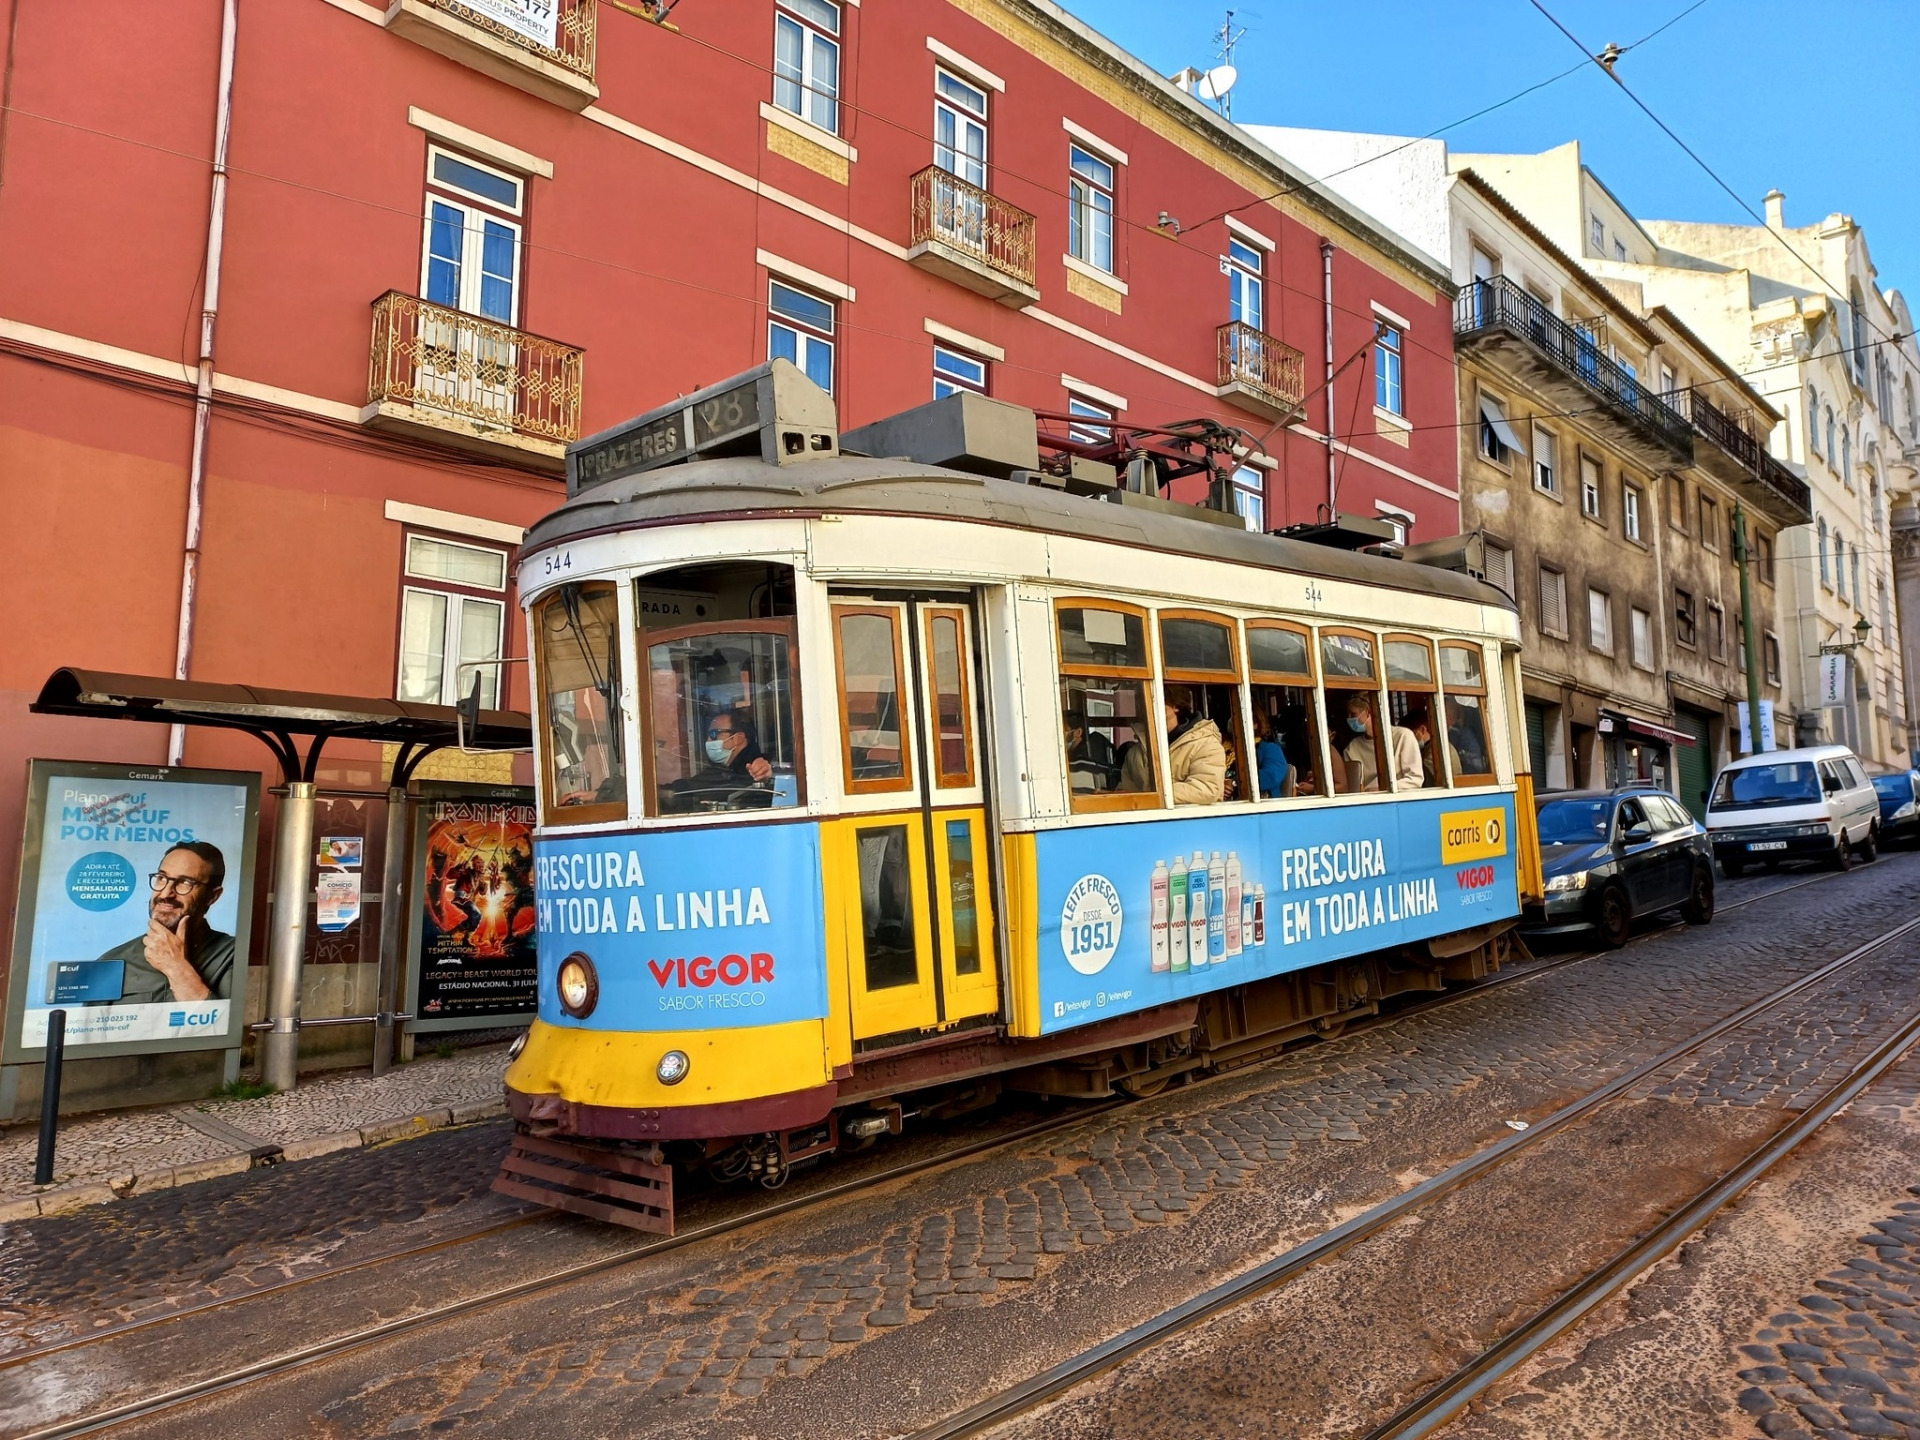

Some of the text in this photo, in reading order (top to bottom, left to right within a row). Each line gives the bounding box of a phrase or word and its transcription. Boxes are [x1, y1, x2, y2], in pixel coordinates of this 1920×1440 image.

[503, 6, 549, 35] PROPERTY
[703, 390, 743, 433] 28
[545, 551, 571, 575] 544
[1305, 587, 1322, 602] 544
[641, 601, 680, 615] RADA
[128, 771, 164, 781] Cemark
[64, 789, 147, 805] Plano cuf
[62, 806, 121, 823] MAIS
[126, 809, 170, 825] CUF
[435, 801, 487, 826] IRON
[61, 825, 110, 841] POR
[1447, 820, 1481, 847] carris
[536, 850, 645, 892] FRESCURA
[1281, 838, 1386, 892] FRESCURA
[1456, 865, 1494, 890] VIGOR
[1064, 878, 1120, 921] LEITE FRESCO
[1460, 890, 1493, 906] SABOR FRESCO
[538, 887, 770, 935] EM TODA A LINHA
[1083, 909, 1102, 922] DESDE
[1282, 877, 1439, 945] EM TODA A LINHA
[1152, 922, 1168, 930] VIGOR
[1171, 920, 1187, 928] VIGOR
[1190, 919, 1206, 927] VIGOR
[1070, 921, 1114, 955] 1951
[428, 947, 473, 955] TEMPTATION
[426, 971, 457, 980] LEGACY
[464, 970, 489, 978] BEAST
[491, 968, 521, 977] WORLD
[647, 952, 775, 989] VIGOR
[439, 981, 470, 990] ESTÁDIO
[658, 991, 766, 1011] SABOR FRESCO
[187, 1009, 219, 1026] cuf
[64, 1024, 130, 1035] t/plano-mais-cuf
